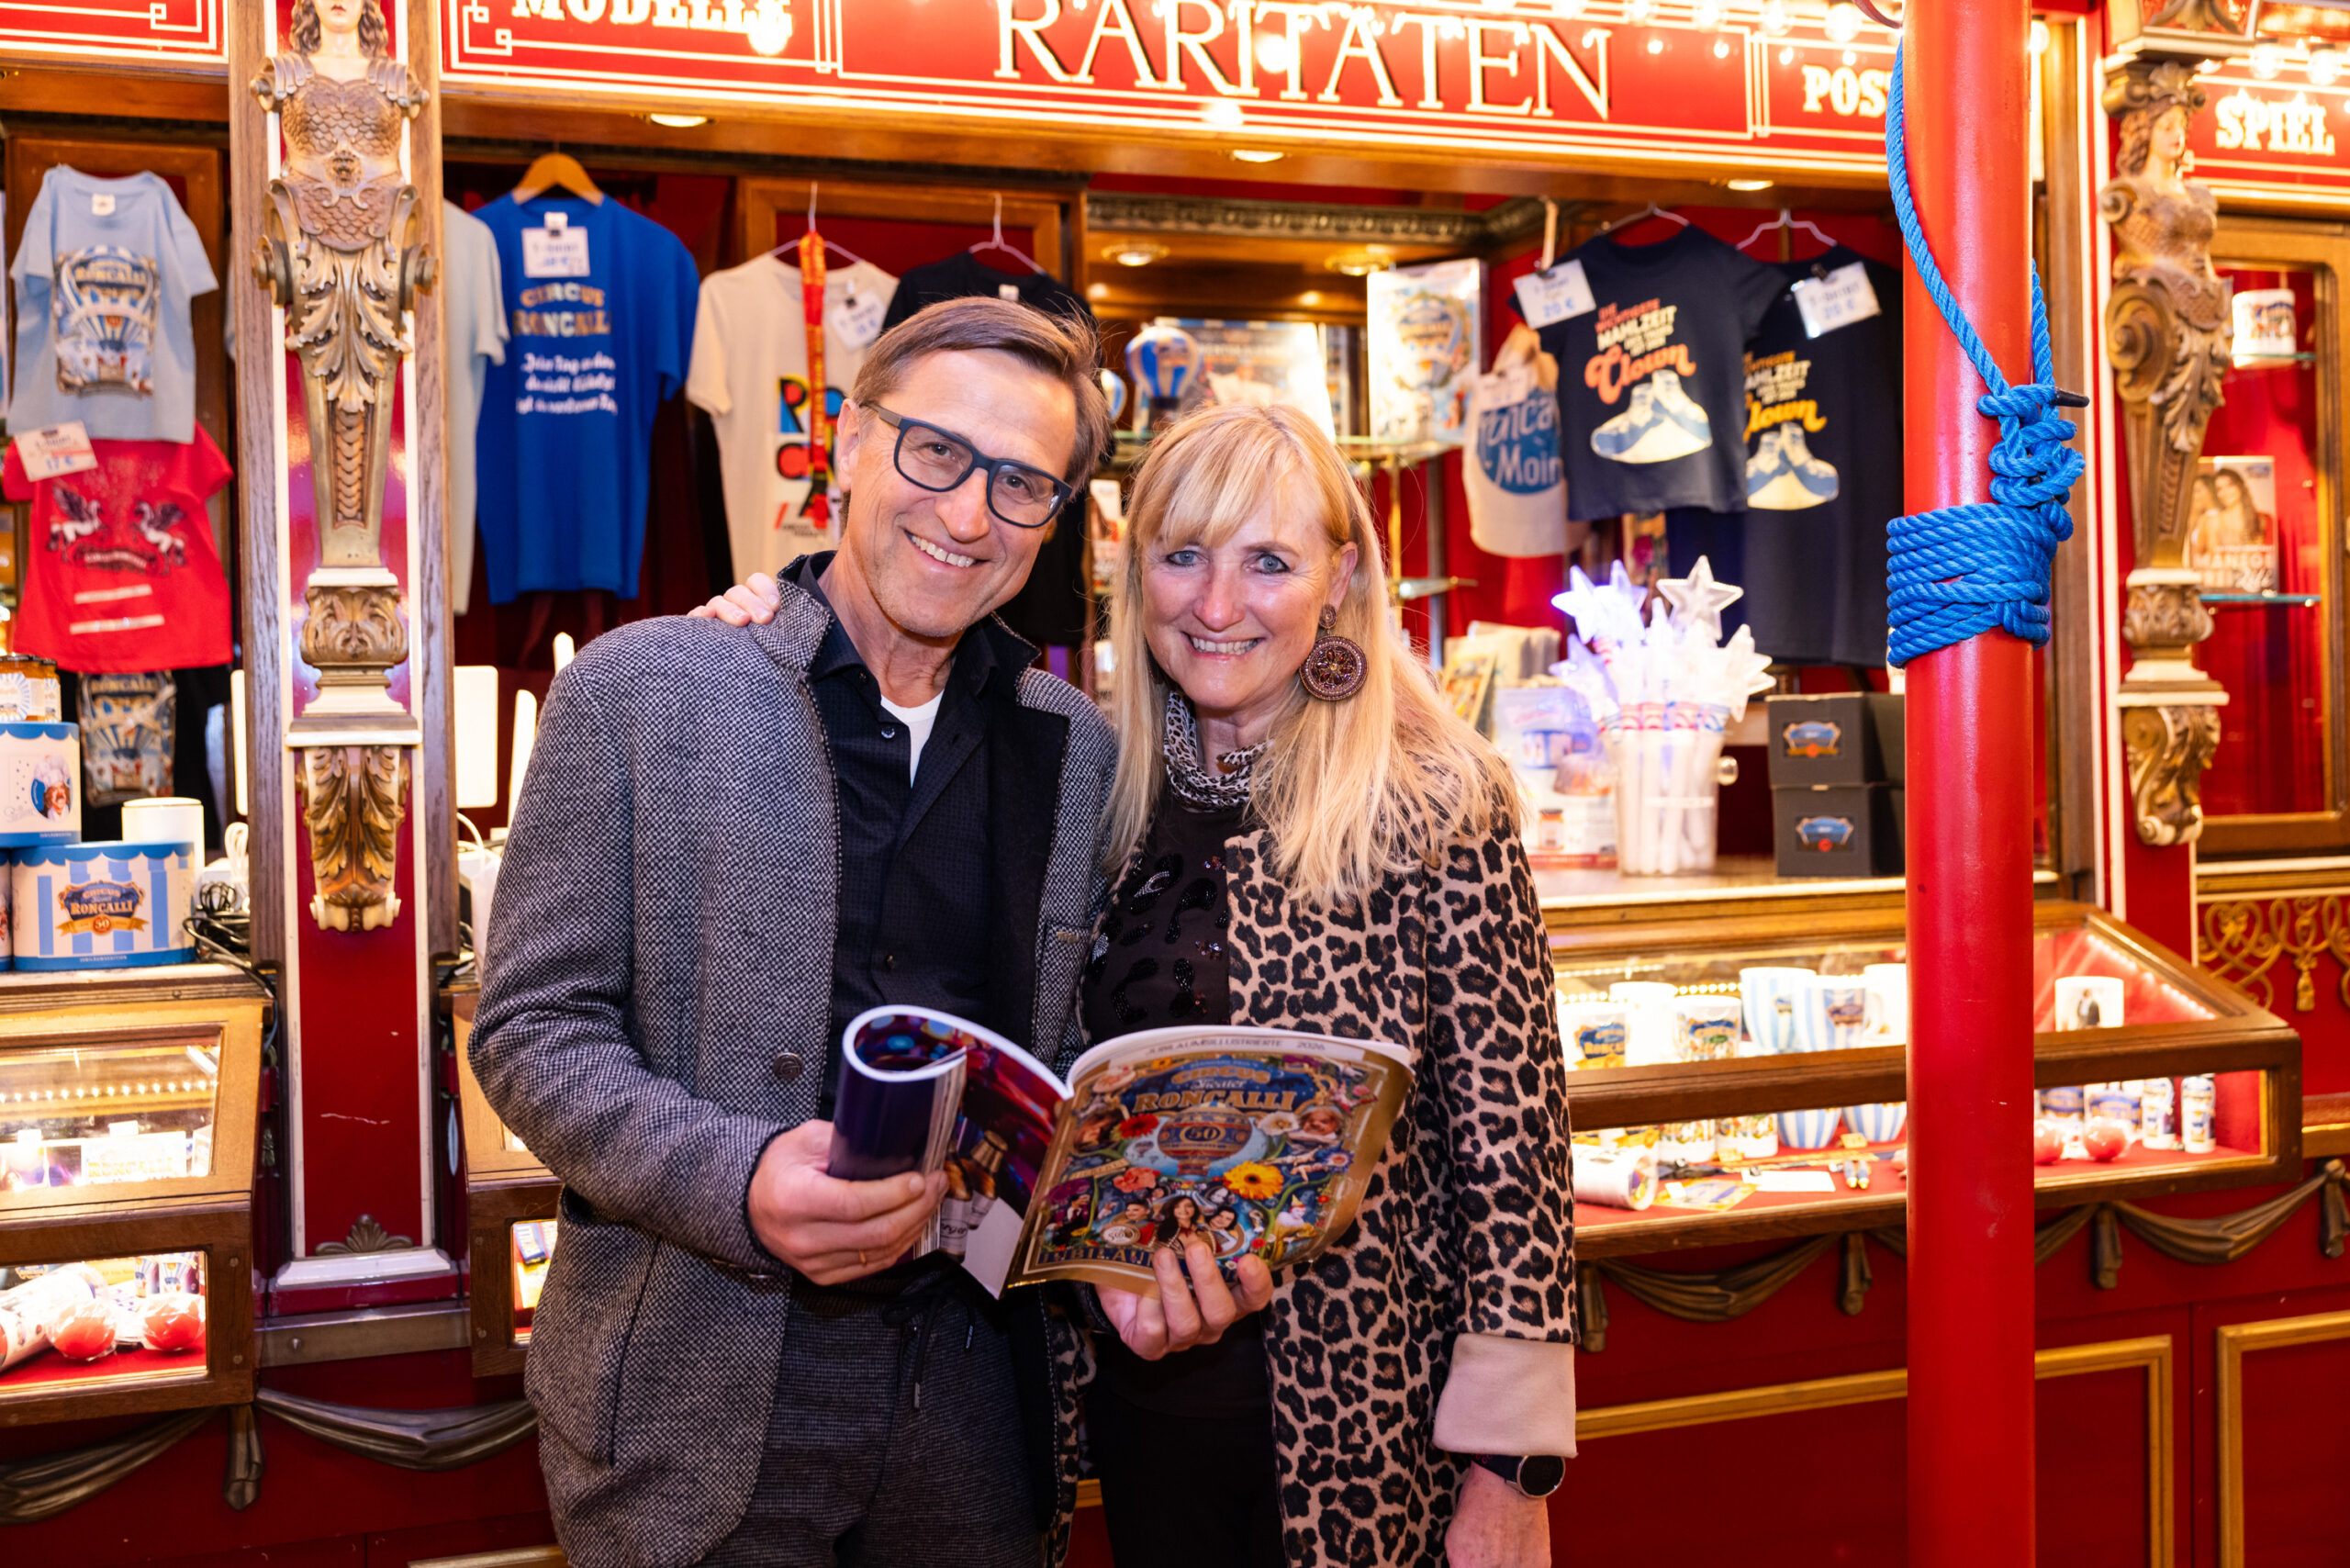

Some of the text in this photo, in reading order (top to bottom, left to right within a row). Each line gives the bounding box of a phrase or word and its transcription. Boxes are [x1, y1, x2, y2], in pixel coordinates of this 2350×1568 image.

[1801, 64, 1893, 118] POS
[2215, 94, 2336, 156] SPIEL
[1597, 305, 1678, 352] MAHLZEIT
[1583, 343, 1696, 404] Clown
[70, 900, 134, 915] RONCALLI
[1171, 1066, 1271, 1084] CIRCUS
[1132, 1090, 1297, 1114] RONCALLI
[1188, 1125, 1219, 1140] 50
